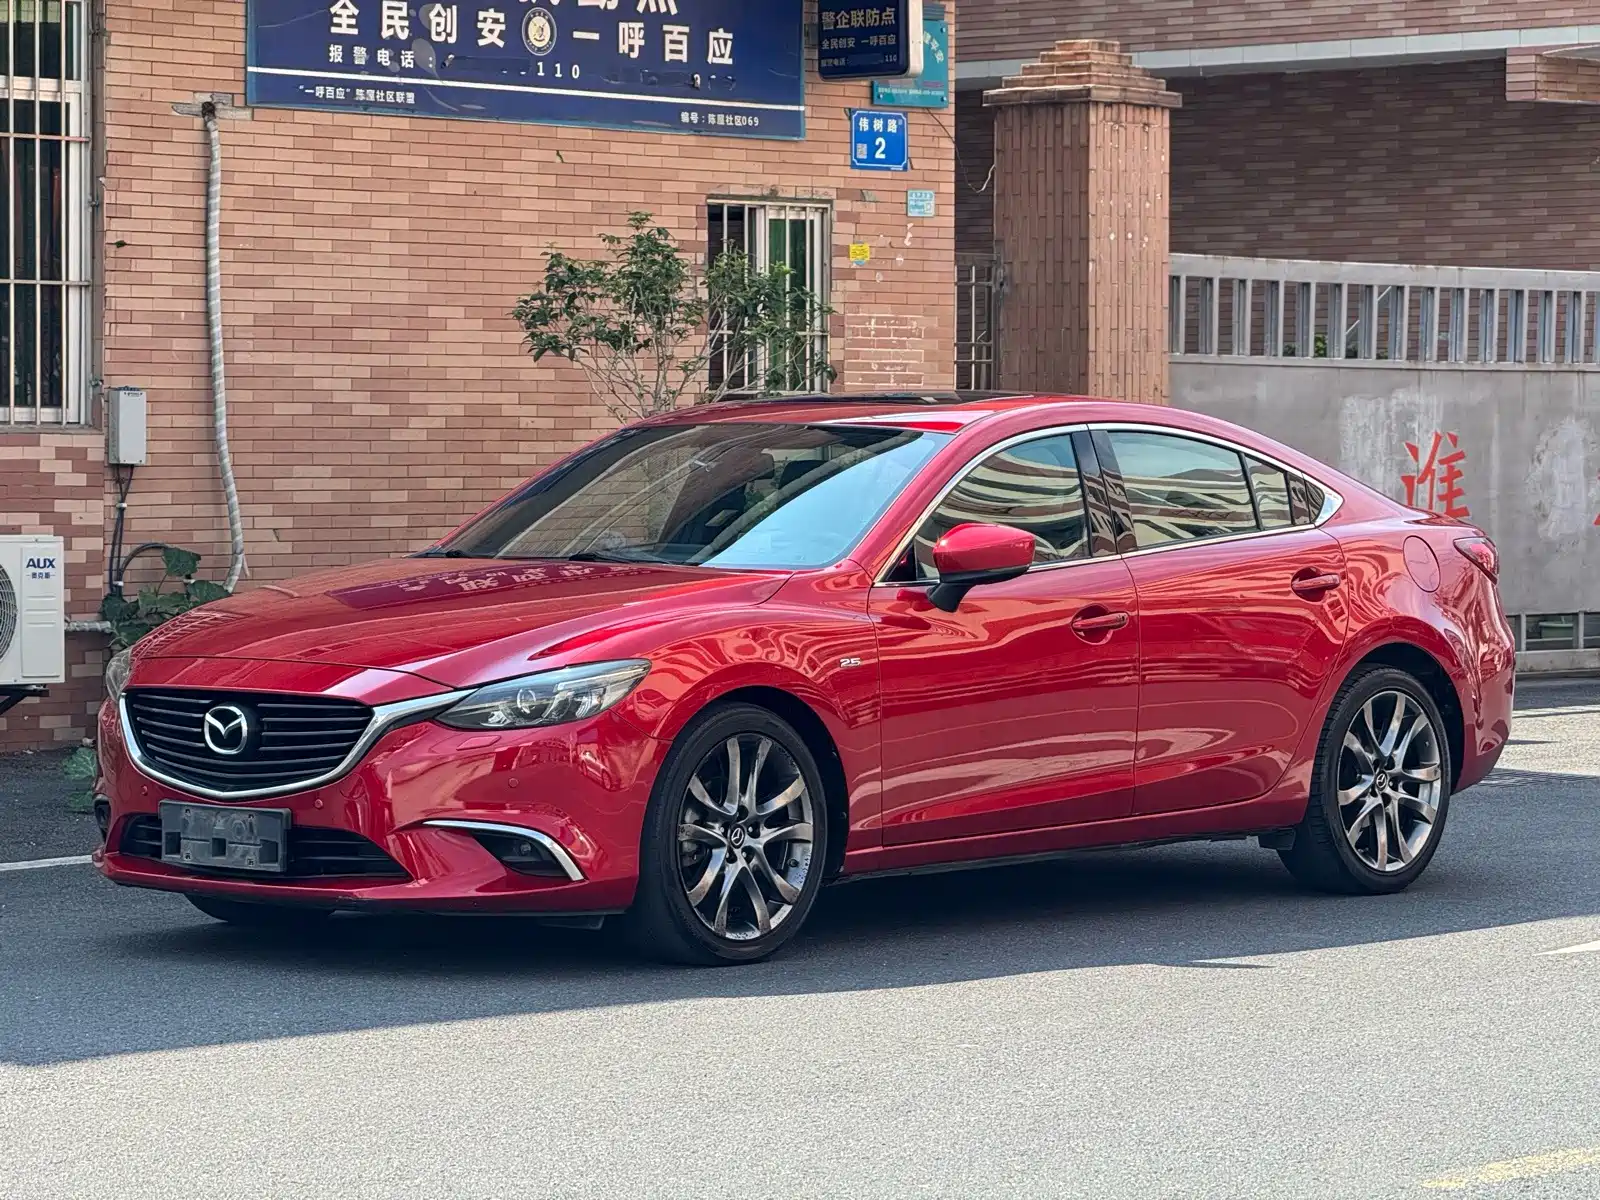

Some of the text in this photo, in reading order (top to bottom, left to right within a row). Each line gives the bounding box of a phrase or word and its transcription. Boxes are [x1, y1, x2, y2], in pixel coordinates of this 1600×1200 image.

[821, 7, 896, 31] 警企联防点
[329, 0, 506, 48] 全民创安
[573, 21, 734, 65] 一呼百应
[821, 34, 897, 50] 全民创安 一呼百应
[536, 61, 581, 80] 110
[858, 116, 898, 133] 伟树路
[874, 136, 886, 159] 2
[26, 557, 57, 569] AUX
